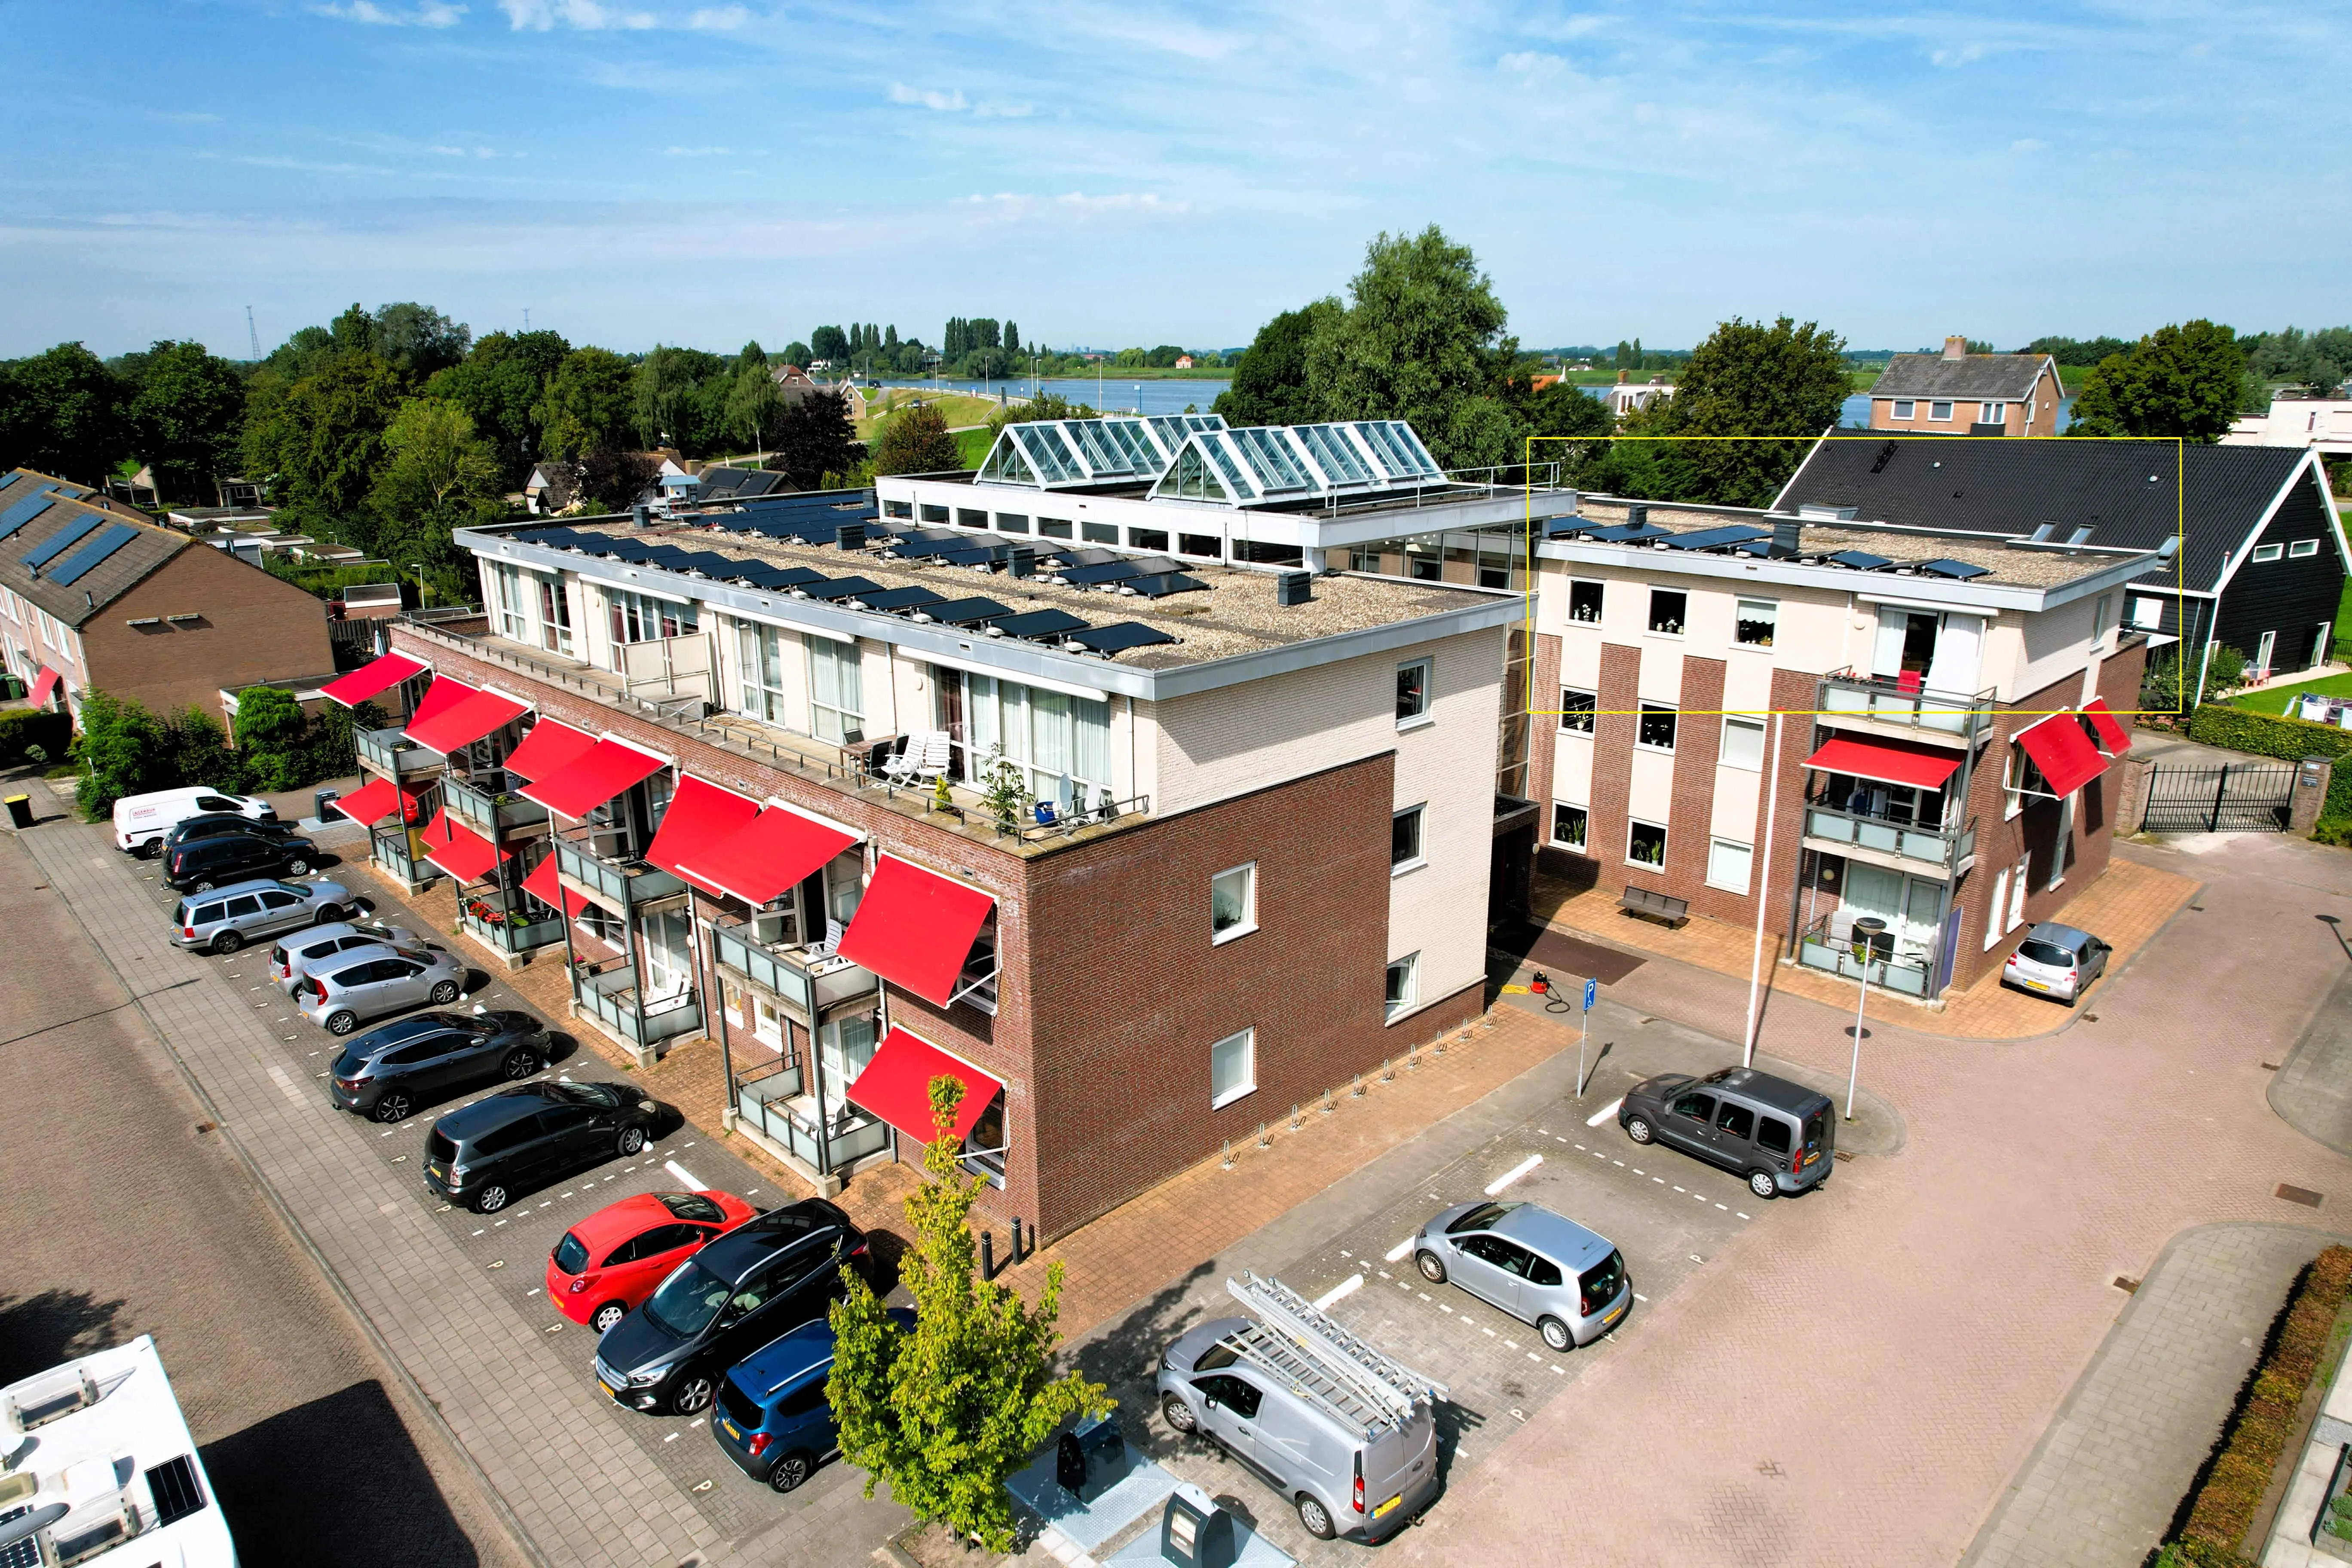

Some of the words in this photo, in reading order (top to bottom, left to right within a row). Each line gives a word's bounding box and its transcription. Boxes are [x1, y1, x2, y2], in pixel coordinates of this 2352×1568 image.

[1587, 983, 1594, 997] P
[487, 1260, 504, 1268] P
[1689, 1255, 1704, 1264] P
[545, 1323, 563, 1332] P
[1510, 1409, 1526, 1422] P
[692, 1479, 713, 1491] P
